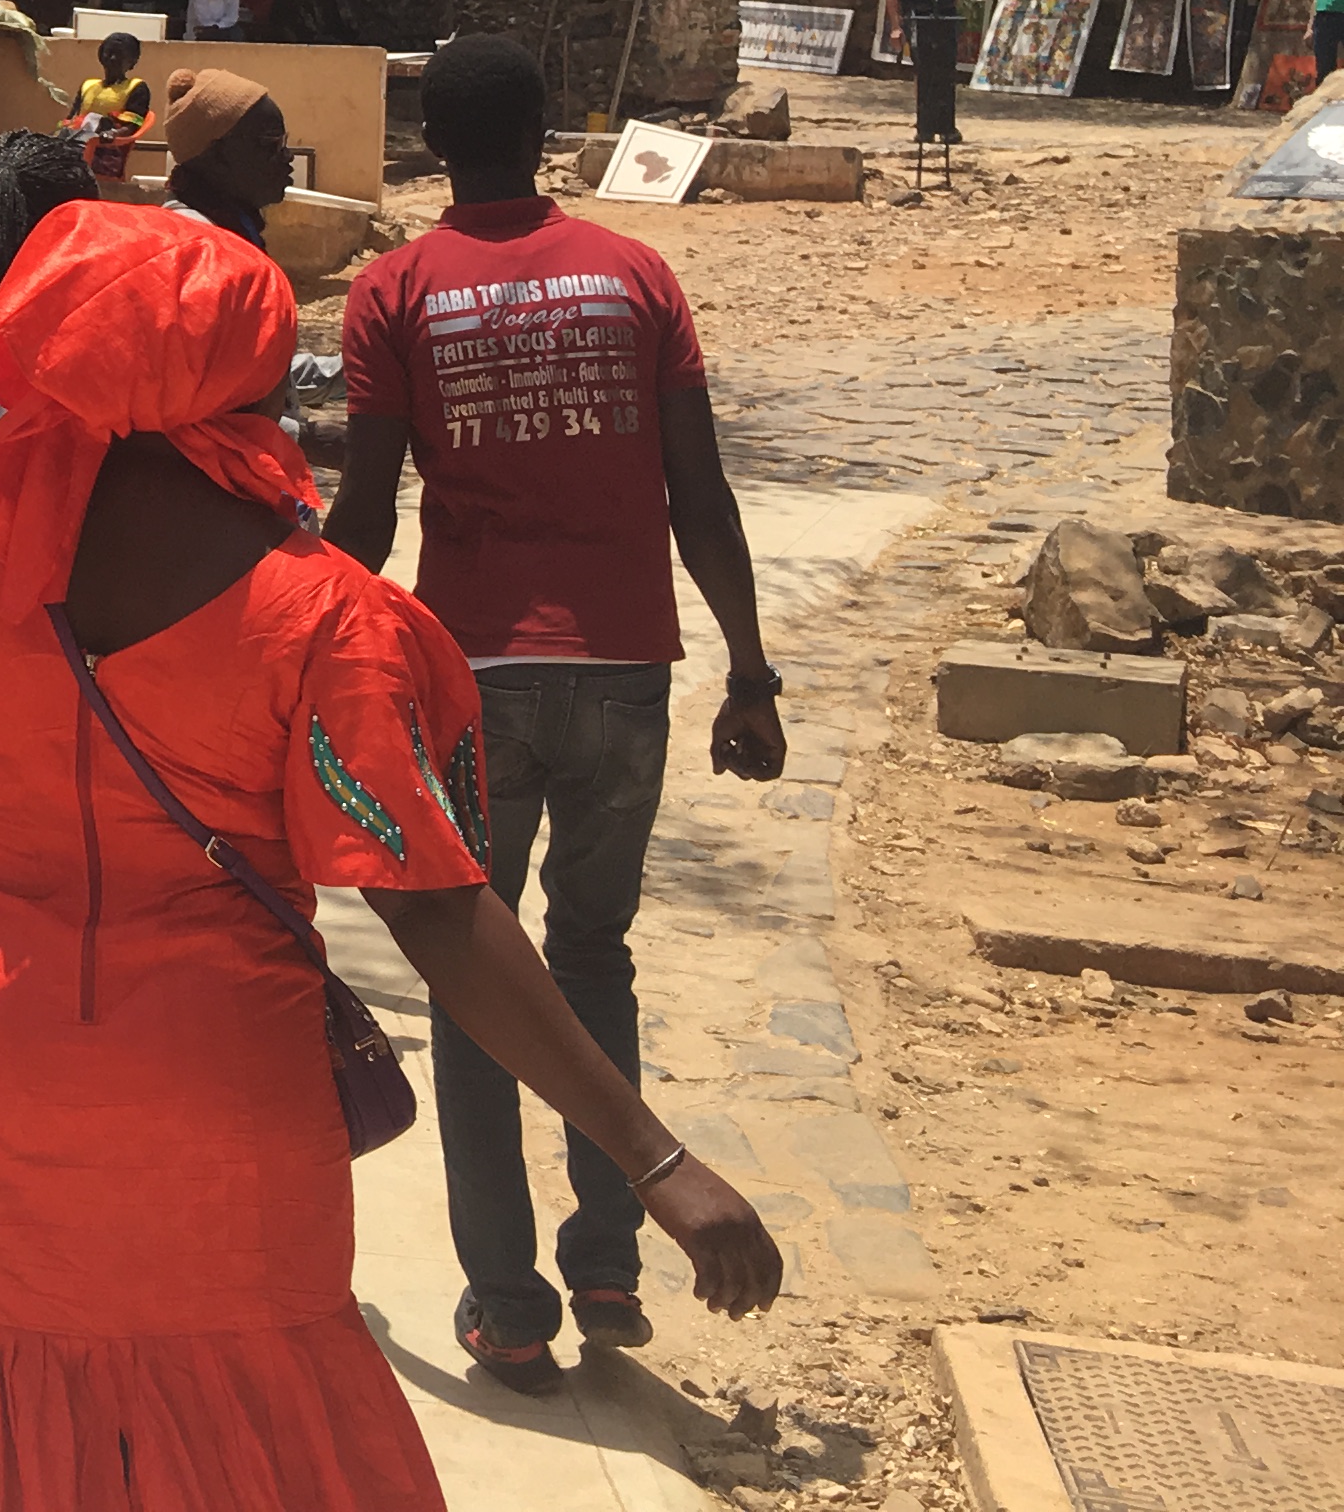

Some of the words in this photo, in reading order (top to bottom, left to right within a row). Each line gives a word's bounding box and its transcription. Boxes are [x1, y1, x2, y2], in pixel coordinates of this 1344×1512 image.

[425, 287, 477, 316] BABA
[476, 279, 544, 307] TOURS
[544, 274, 628, 300] HOLDING
[482, 305, 578, 331] Voyage
[432, 337, 499, 366] FAITES
[503, 330, 556, 354] VOUS
[561, 325, 636, 348] PLAISIR
[438, 373, 500, 398] Construction
[553, 386, 589, 406] Multi
[446, 418, 482, 449] 77
[496, 412, 551, 443] 429
[561, 407, 602, 437] 34
